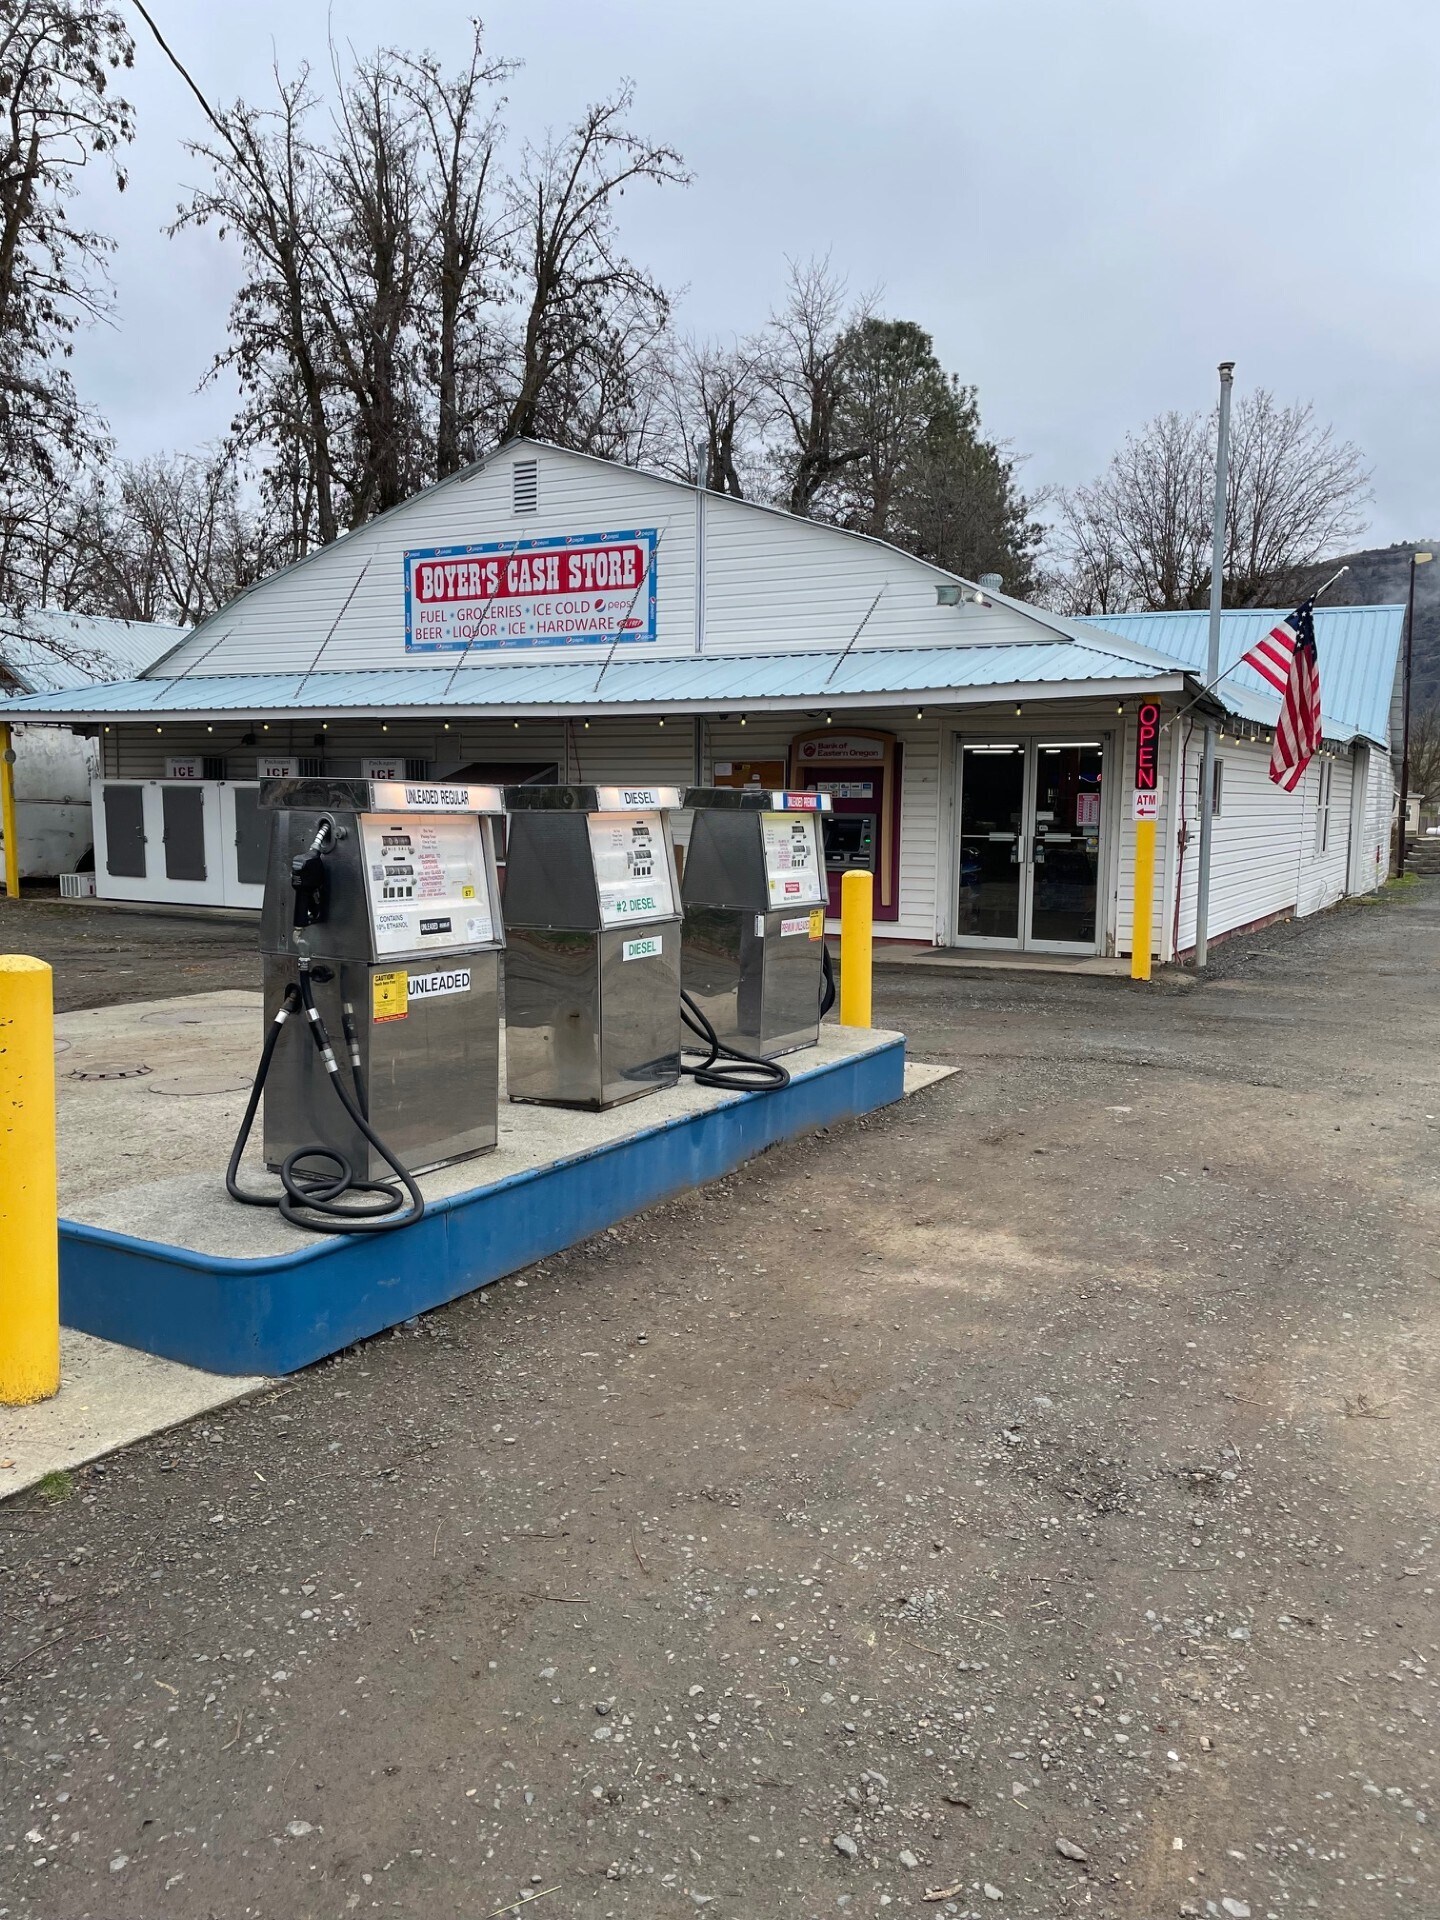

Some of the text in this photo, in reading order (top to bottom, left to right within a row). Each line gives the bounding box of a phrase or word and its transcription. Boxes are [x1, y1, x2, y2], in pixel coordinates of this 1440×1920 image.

[421, 561, 499, 599] BOYER'S
[507, 556, 559, 593] CASH
[568, 549, 635, 588] STORE
[420, 610, 447, 623] FUEL
[457, 604, 522, 621] GROCERIES
[533, 603, 552, 616] ICE
[555, 600, 590, 614] COLD
[415, 627, 443, 640] BEER
[453, 623, 498, 638] LIQUOR
[508, 622, 526, 635] ICE
[537, 617, 614, 633] HARDWARE
[817, 749, 879, 757] Eastern Oregon
[1138, 704, 1158, 788] OPEN
[173, 766, 195, 777] ICE
[405, 789, 469, 805] UNLEADED REGULAR
[624, 791, 655, 804] DIESEL
[1136, 795, 1156, 806] ATM
[617, 900, 627, 912] #2
[629, 897, 657, 911] DIESEL
[380, 914, 404, 922] CONTAINS
[387, 922, 408, 930] ETHANOL
[628, 940, 657, 956] DIESEL
[408, 972, 470, 996] UNLEADED
